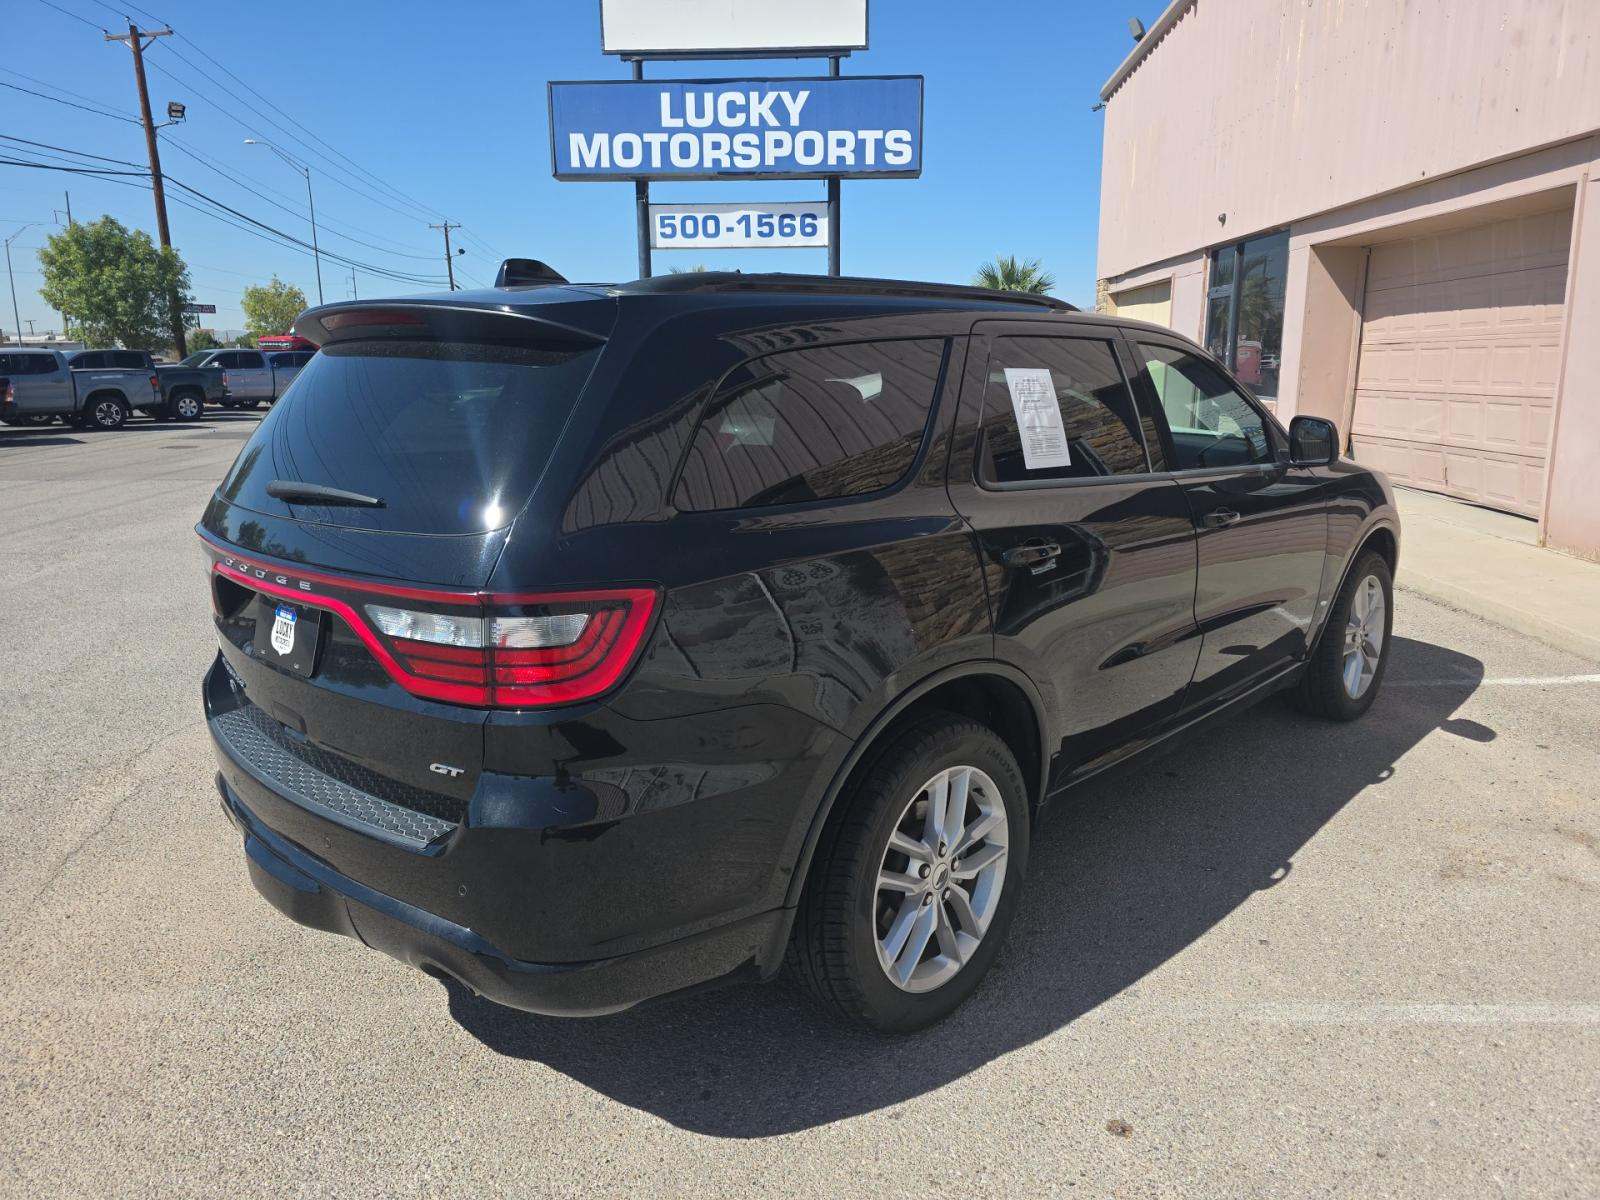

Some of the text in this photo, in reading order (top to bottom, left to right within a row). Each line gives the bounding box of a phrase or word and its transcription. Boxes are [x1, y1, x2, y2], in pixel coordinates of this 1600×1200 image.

[660, 91, 811, 128] LUCKY
[568, 129, 913, 168] MOTORSPORTS
[658, 213, 819, 239] 500-1566
[225, 557, 312, 591] DODGE
[429, 763, 465, 777] GT
